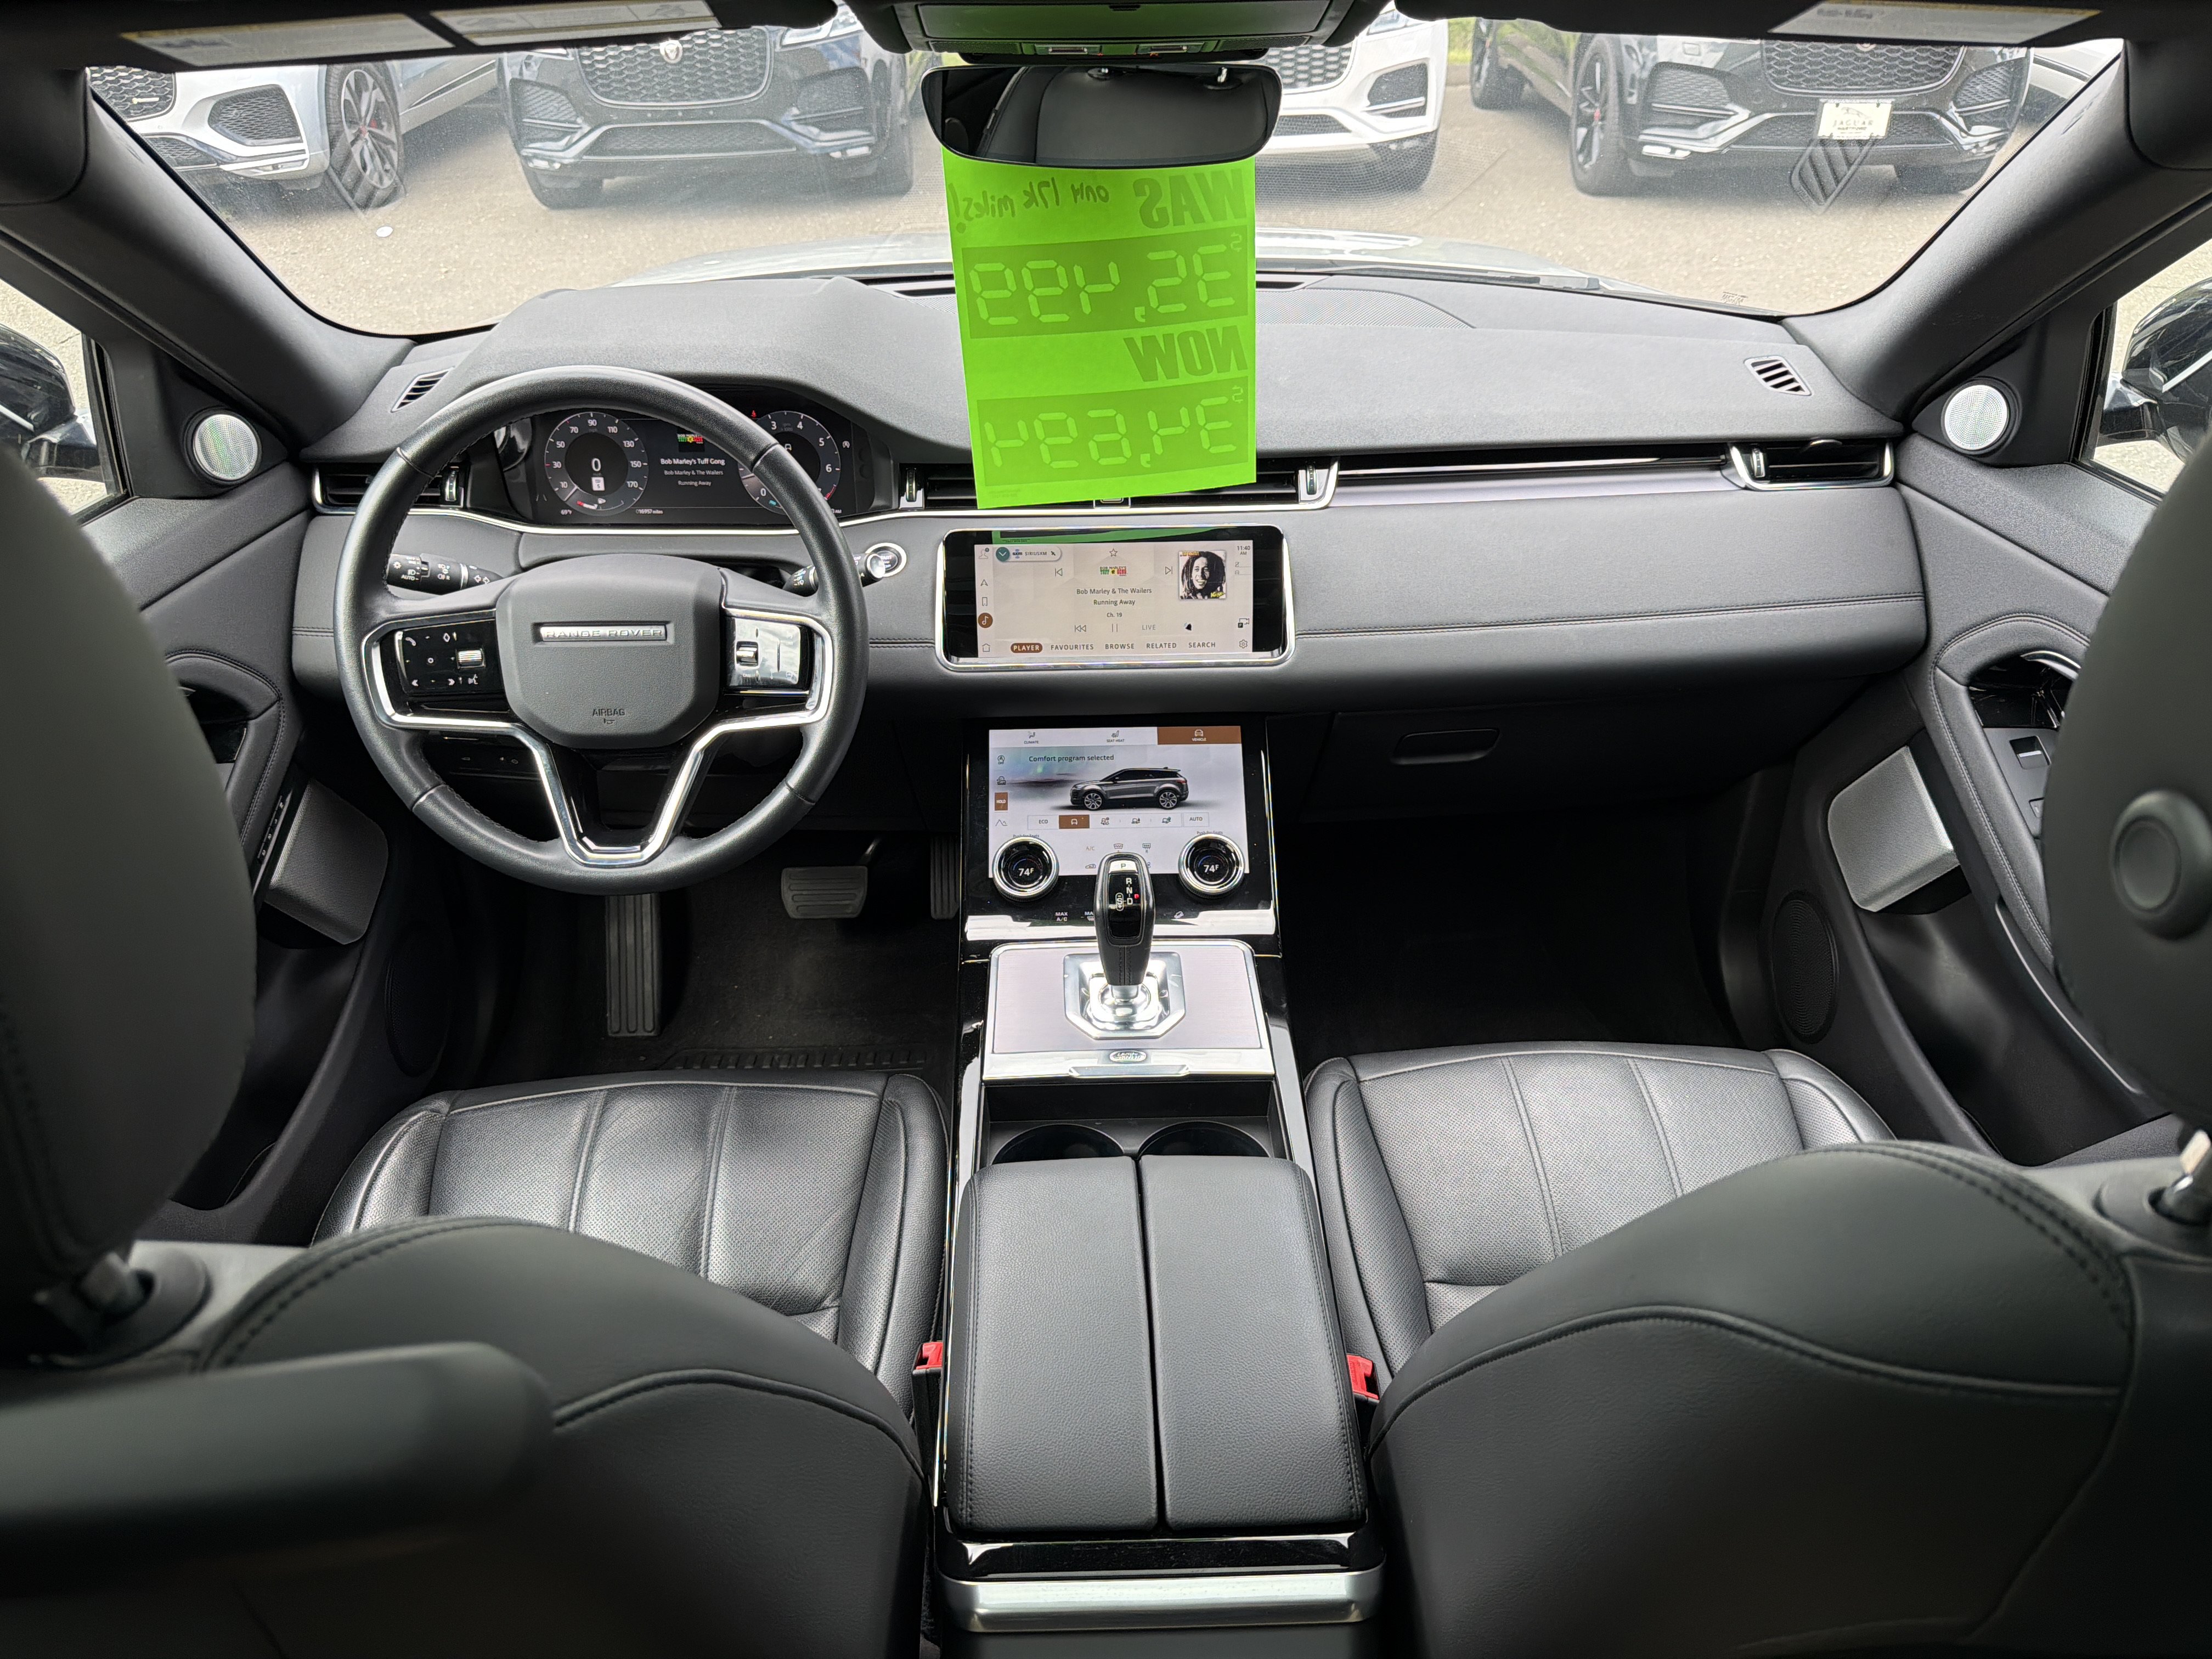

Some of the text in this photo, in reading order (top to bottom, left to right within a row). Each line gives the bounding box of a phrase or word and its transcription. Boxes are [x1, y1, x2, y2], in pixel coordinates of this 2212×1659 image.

[771, 421, 777, 430] 3
[797, 421, 803, 430] 4
[819, 438, 825, 446] 5
[592, 458, 601, 471] 0
[826, 464, 832, 472] 6
[546, 630, 601, 638] RANGE
[592, 708, 625, 716] AIRBAG
